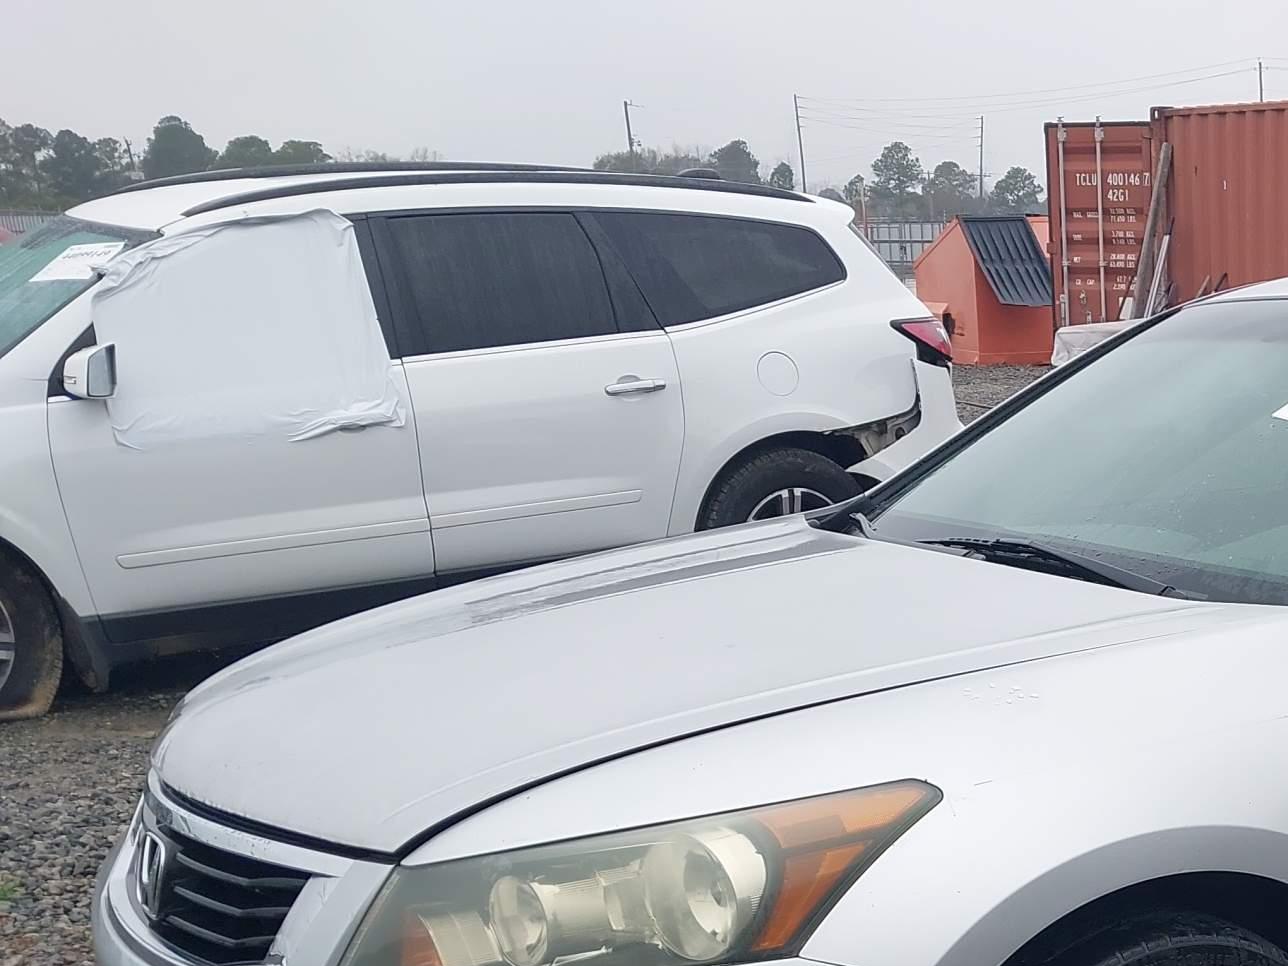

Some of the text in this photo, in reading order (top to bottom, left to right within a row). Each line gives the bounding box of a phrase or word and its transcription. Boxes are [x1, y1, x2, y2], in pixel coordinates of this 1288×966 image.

[1075, 173, 1097, 186] TCLU
[1107, 172, 1140, 186] 400146
[1107, 188, 1129, 201] 42G1
